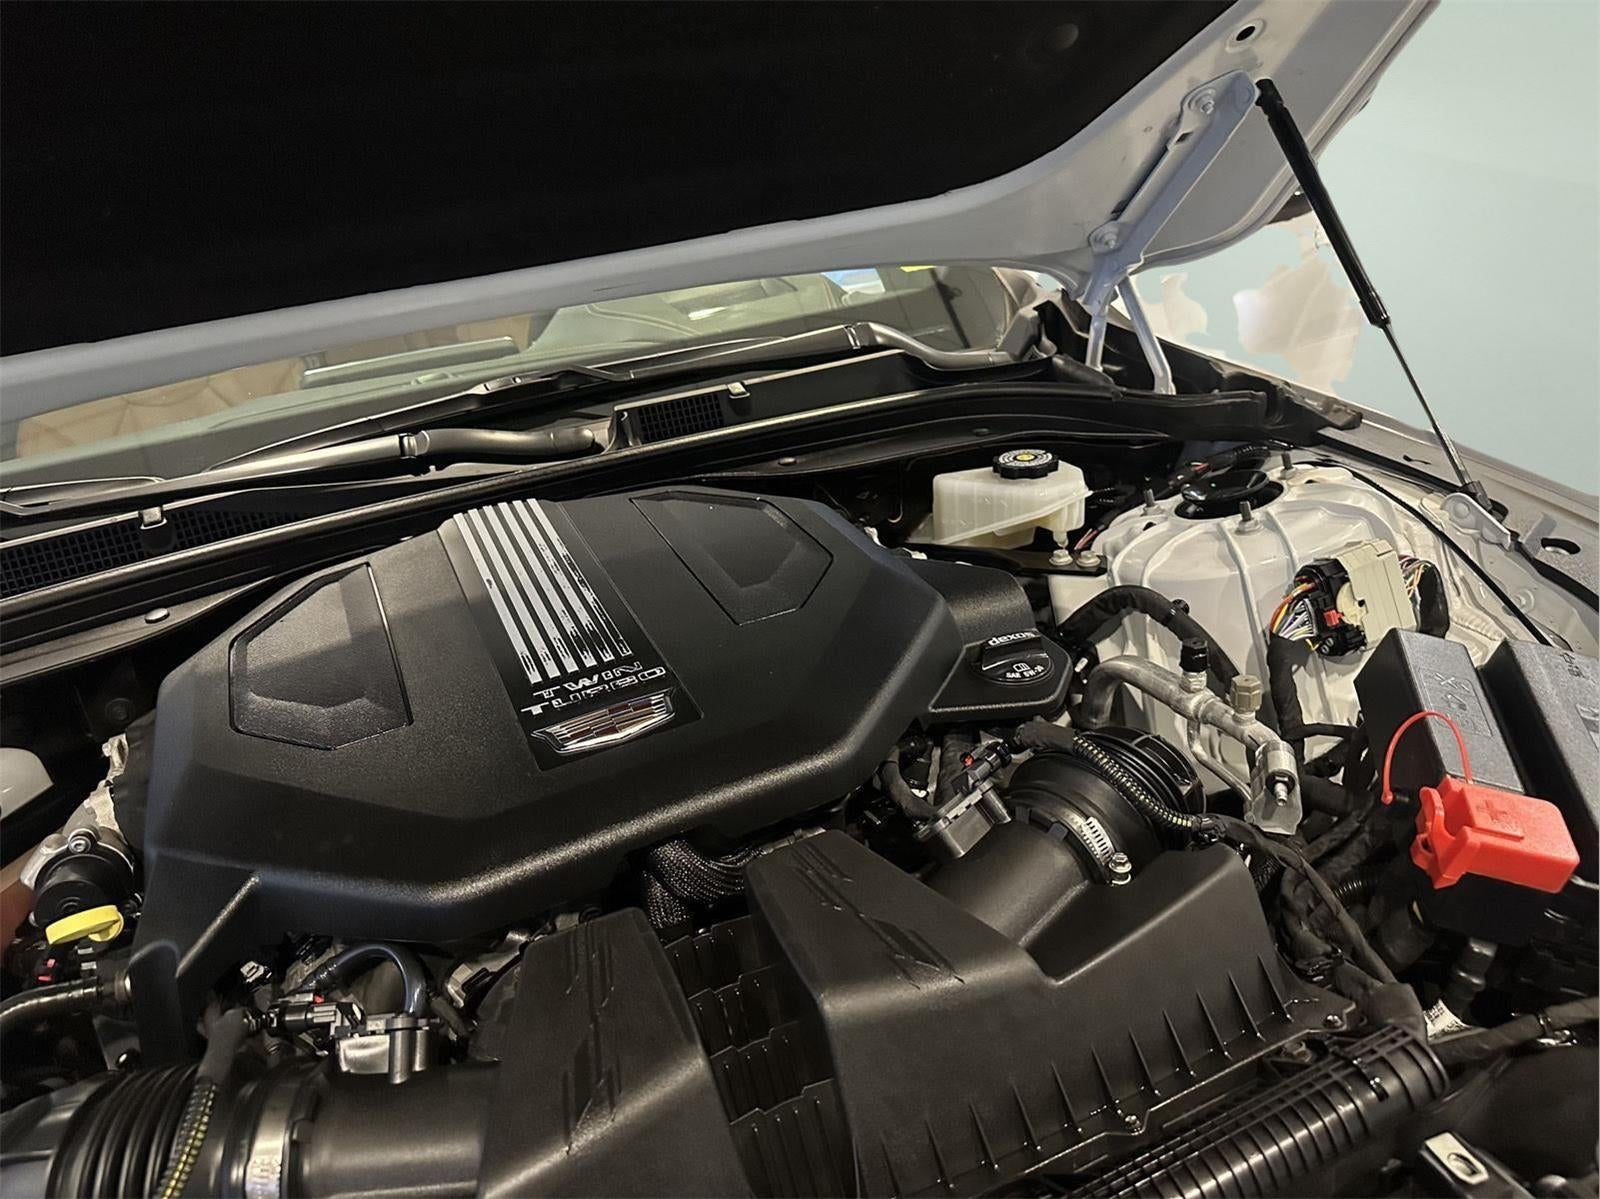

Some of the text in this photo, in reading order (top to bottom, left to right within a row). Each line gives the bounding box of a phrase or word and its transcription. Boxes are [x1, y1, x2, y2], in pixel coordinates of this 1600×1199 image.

[988, 632, 1036, 646] dexos
[520, 666, 667, 716] TURBO
[532, 660, 644, 699] TWIN
